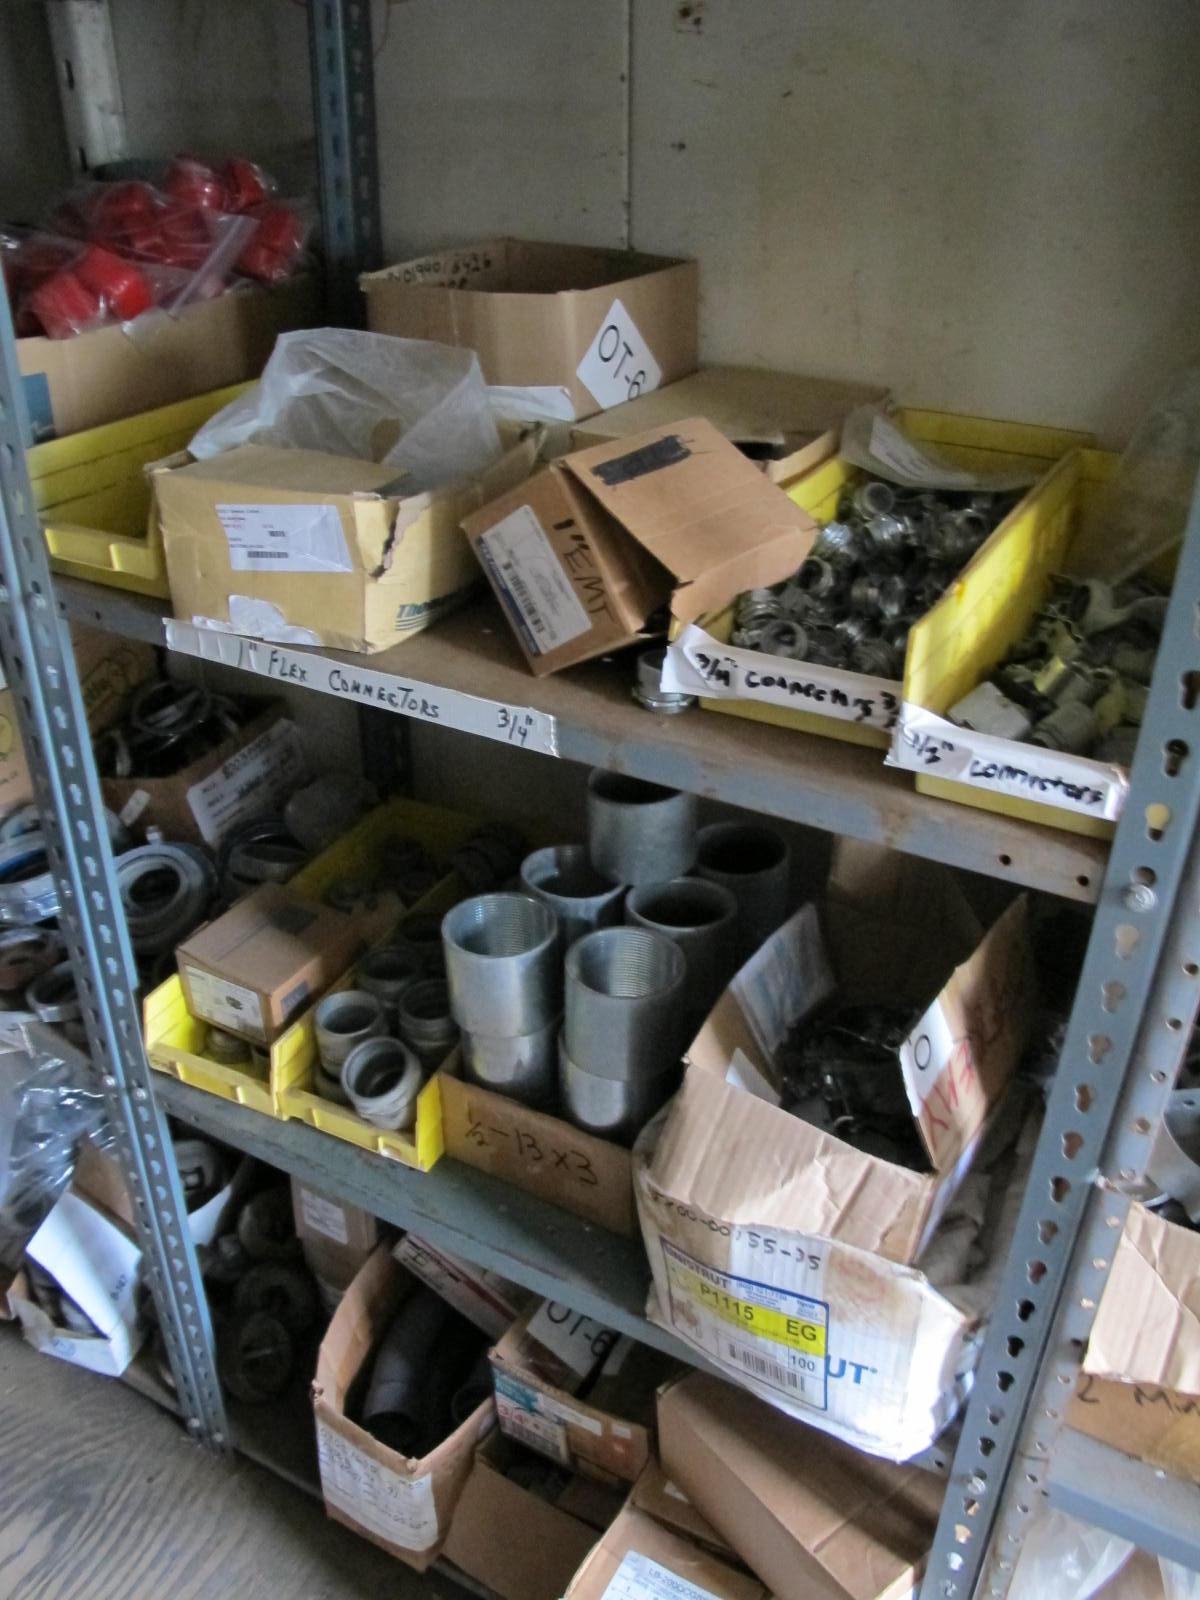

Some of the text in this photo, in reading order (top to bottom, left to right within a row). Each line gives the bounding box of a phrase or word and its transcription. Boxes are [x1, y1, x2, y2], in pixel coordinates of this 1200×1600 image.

[267, 649, 308, 684] FLEX
[328, 668, 441, 720] CONNECTORS
[496, 708, 534, 744] 3/4"
[699, 1284, 755, 1322] P1115
[785, 1318, 818, 1342] EG
[789, 1353, 816, 1373] 100
